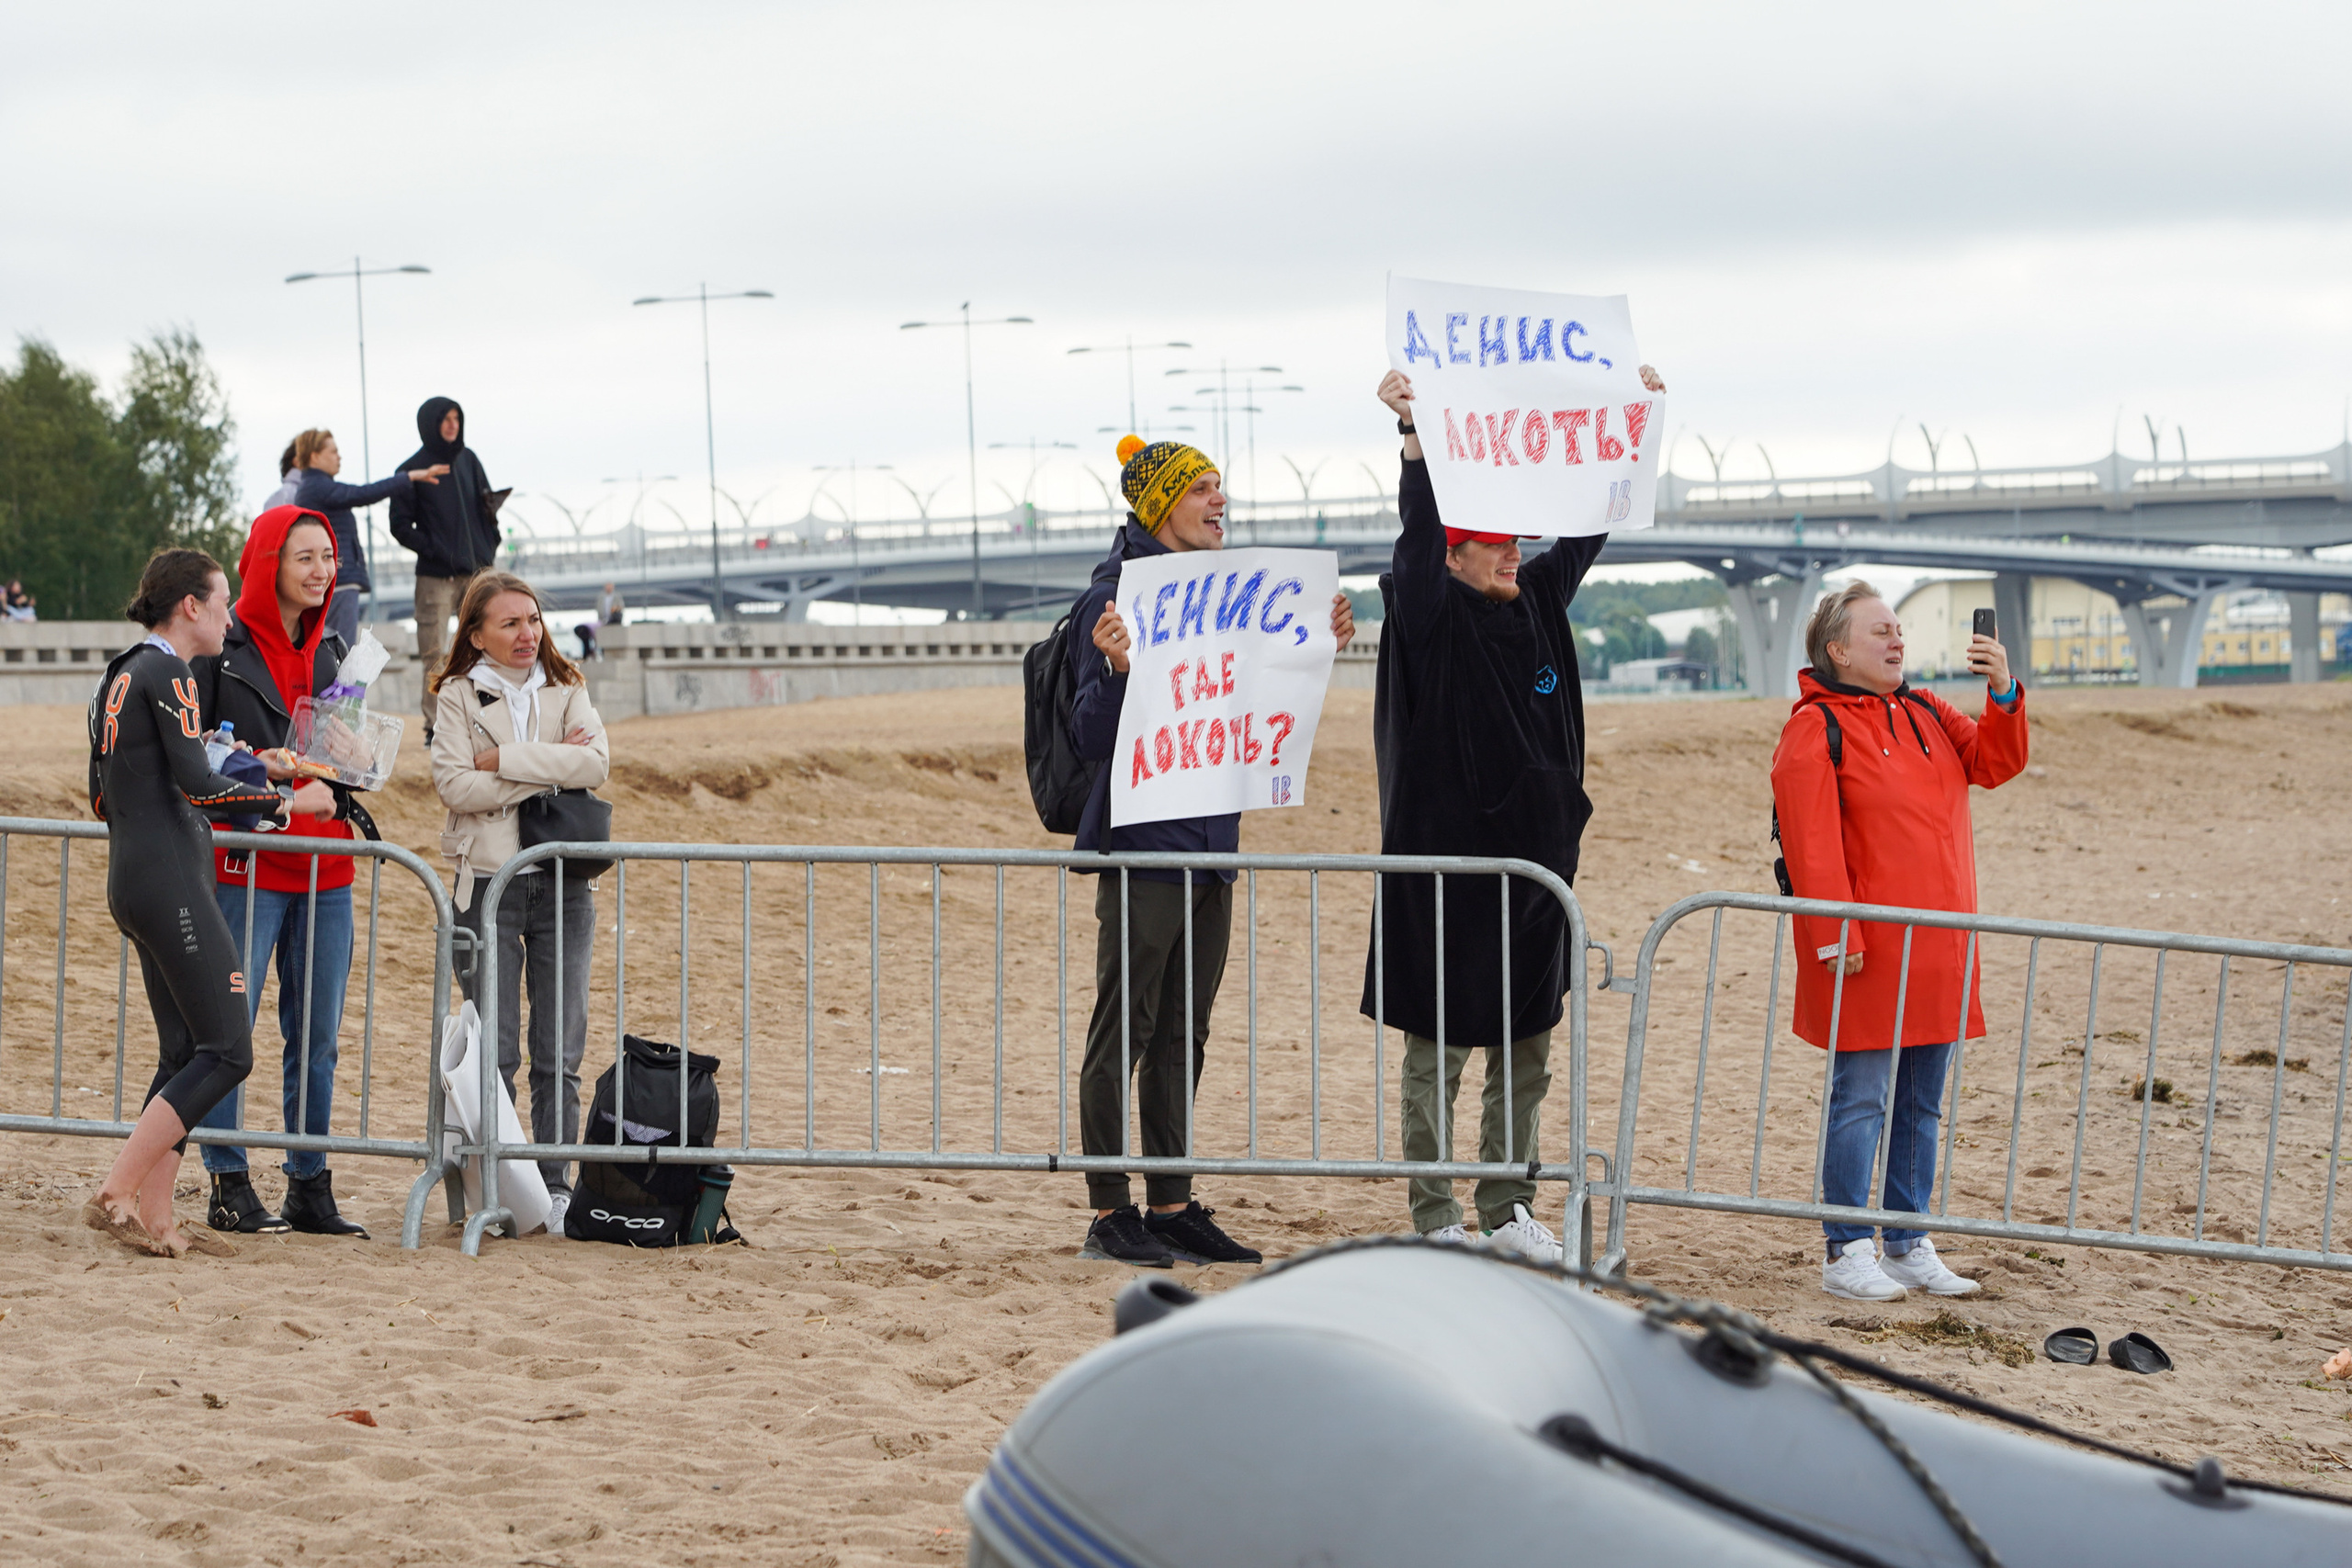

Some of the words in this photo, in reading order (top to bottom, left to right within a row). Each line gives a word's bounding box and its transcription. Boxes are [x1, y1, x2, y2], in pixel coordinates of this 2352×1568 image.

[1403, 310, 1613, 370] ДЕНИС,
[1443, 400, 1652, 468] ЛОКОТЬ!
[1169, 650, 1235, 712] ГДЕ
[1131, 711, 1295, 789] ЛОКОТЬ?
[1819, 944, 1839, 955] NOO
[590, 1208, 665, 1230] orca
